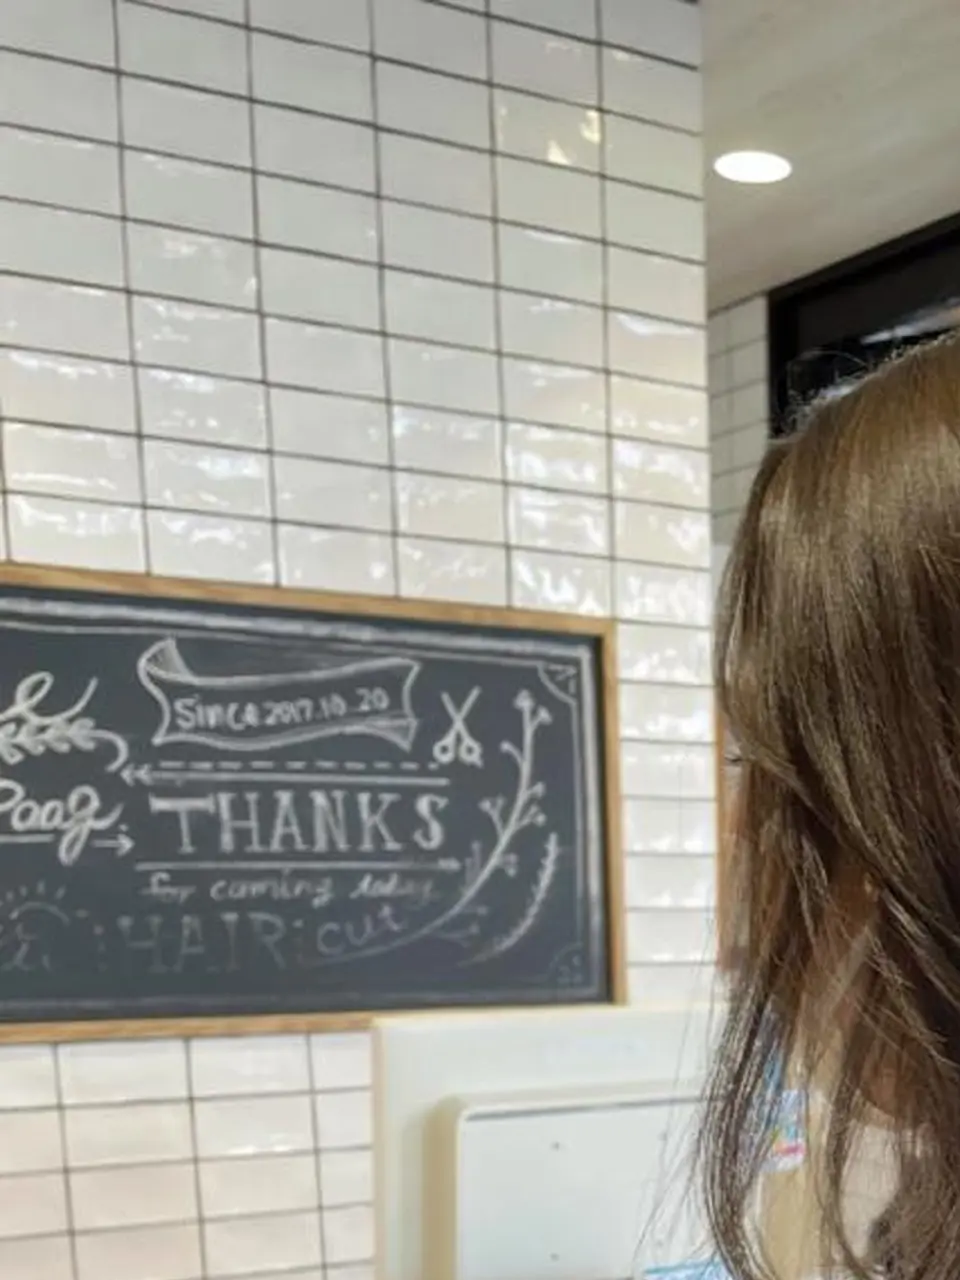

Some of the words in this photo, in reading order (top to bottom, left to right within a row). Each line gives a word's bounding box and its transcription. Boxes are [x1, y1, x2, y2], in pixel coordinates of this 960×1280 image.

[148, 791, 448, 853] THANKS
[209, 866, 333, 909] coming
[116, 911, 286, 973] HAIR
